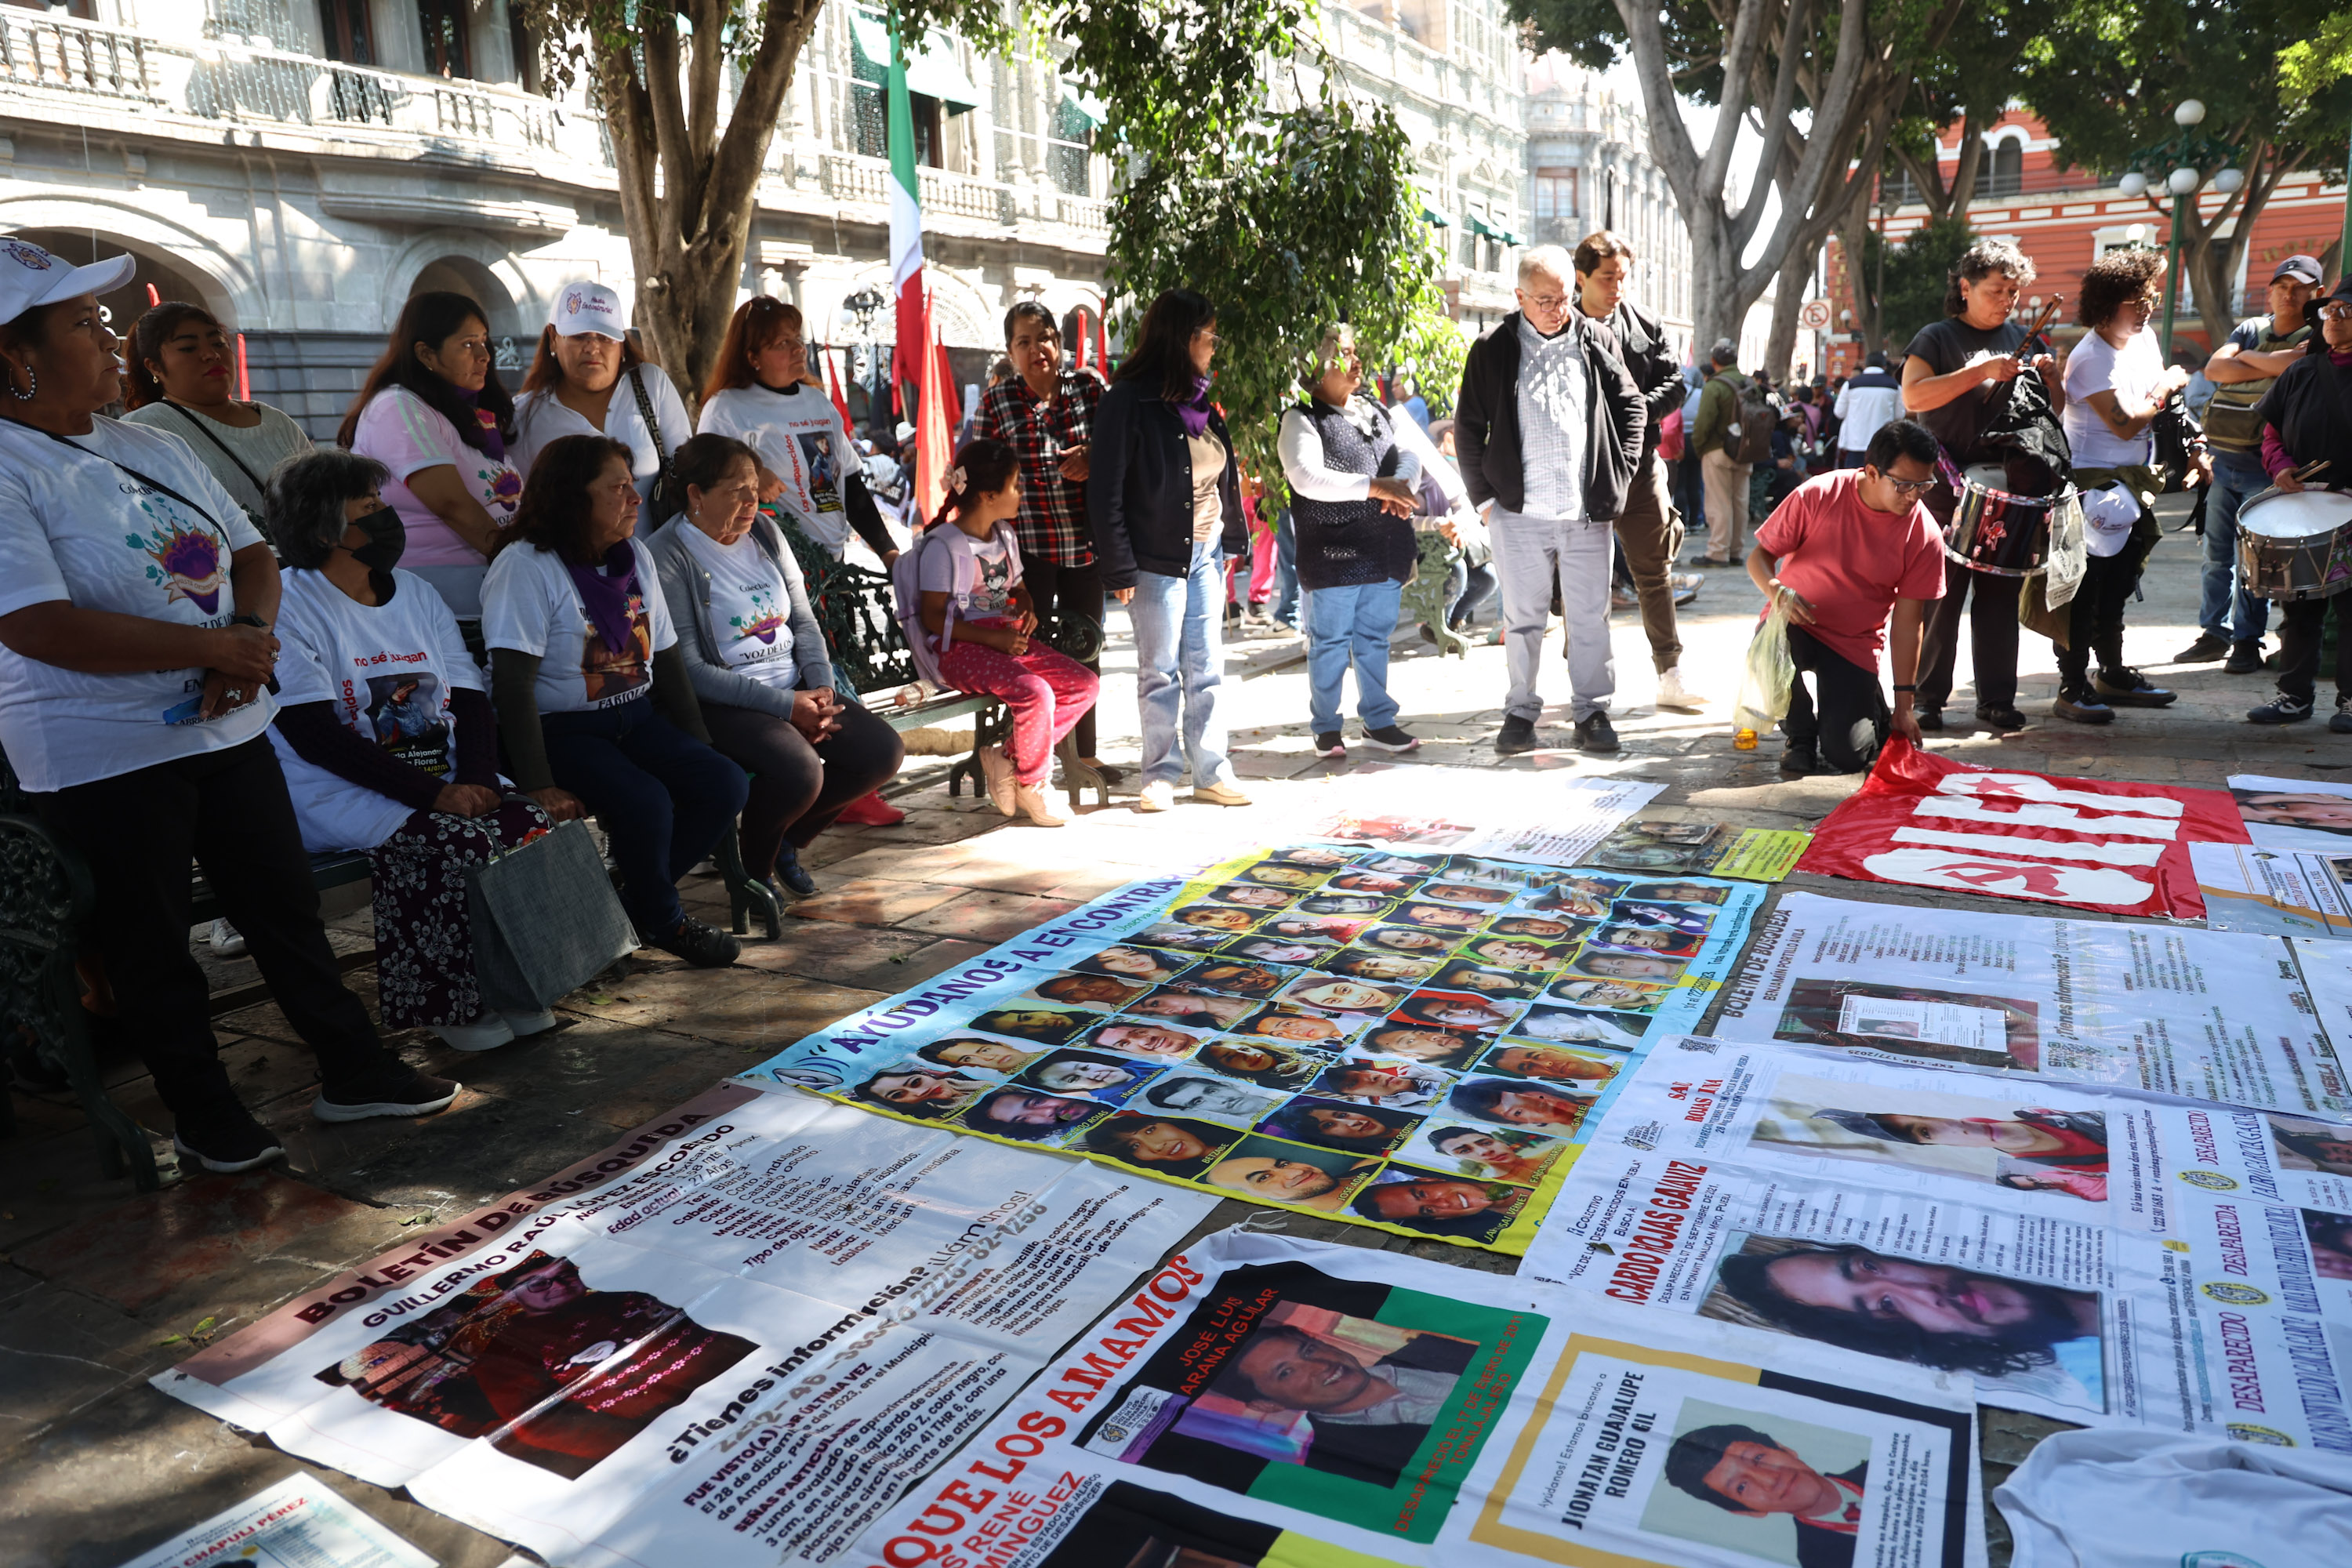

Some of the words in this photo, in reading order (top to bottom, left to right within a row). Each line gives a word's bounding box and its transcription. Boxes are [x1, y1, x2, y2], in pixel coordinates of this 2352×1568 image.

[354, 657, 368, 666] no
[371, 651, 387, 664] sé
[768, 644, 777, 655] DE
[779, 640, 791, 651] LOS
[414, 757, 437, 766] Flores
[829, 957, 1025, 1054] AYÚDANOS
[1010, 949, 1054, 963] A
[1087, 1109, 1109, 1125] ROJAS
[1684, 1098, 1713, 1123] ROJAS
[2187, 1110, 2220, 1166] DESAPARECIDO
[1201, 1142, 1230, 1164] BETZABE
[607, 1210, 644, 1235] Edad
[690, 1170, 710, 1187] 27
[705, 1157, 735, 1180] Años
[672, 1197, 724, 1226] Cabello:
[684, 1192, 712, 1207] Tez:
[699, 1203, 738, 1224] Color:
[783, 1149, 822, 1174] oscuro.
[714, 1207, 751, 1225] Cara:
[742, 1249, 773, 1268] Tipo
[771, 1236, 791, 1251] de
[789, 1223, 819, 1242] ojos:
[872, 1152, 921, 1183] rasgados.
[808, 1229, 845, 1251] Nariz:
[917, 1148, 964, 1177] mediana.
[1337, 1182, 1356, 1202] JOSÉ
[1352, 1171, 1370, 1190] ADAN
[1575, 1195, 1603, 1230] COLECTIVO
[1590, 1189, 1626, 1242] DESAPARECIDOS
[361, 1254, 506, 1329] GUILLERMO
[505, 1210, 569, 1256] RAÚL
[566, 1184, 637, 1212] LÓPEZ
[638, 1124, 735, 1184] ESCOBEDO
[711, 1209, 765, 1238] Mentón:
[732, 1212, 777, 1238] Orejas:
[746, 1217, 791, 1240] Frente:
[764, 1219, 804, 1242] Cejas:
[822, 1234, 860, 1257] Boca:
[829, 1239, 876, 1267] Labios:
[1004, 1267, 1029, 1291] color
[1071, 1196, 1108, 1229] navideño
[1613, 1216, 1634, 1237] BUSCA
[1628, 1210, 1685, 1256] ROJAS
[1658, 1259, 1683, 1304] DESAPARECIÓ
[1689, 1205, 1710, 1241] SEPTIEMBRE
[2214, 1205, 2248, 1276] DESAPARECIDA
[294, 1229, 480, 1327] BOLETÍN
[473, 1201, 534, 1232] DE
[971, 1300, 1011, 1325] imagen
[1017, 1267, 1047, 1290] Santa
[1072, 1228, 1095, 1247] reno.
[1000, 1305, 1034, 1333] -Botas
[1127, 1206, 1150, 1225] negro
[1002, 1240, 1041, 1276] mezclilla
[1605, 1252, 1665, 1305] ICARDO
[927, 1267, 996, 1317] VESTIMENTA
[986, 1289, 1039, 1328] -Chamarra
[1047, 1262, 1067, 1283] piel
[1011, 1312, 1044, 1337] líneas
[1041, 1298, 1068, 1318] rojas.
[667, 1377, 775, 1465] ¿Tienes
[925, 1189, 1030, 1269] ¡Llámanos!
[1179, 1329, 1221, 1369] JOSÉ
[1214, 1294, 1243, 1332] LUIS
[1179, 1341, 1233, 1396] ARANA
[1227, 1286, 1279, 1345] AGUILAR
[968, 1409, 1067, 1495] LOS
[1045, 1254, 1206, 1414] AMAMOS
[2219, 1311, 2266, 1414] DESAPARECIDO
[682, 1479, 717, 1508] FUE
[710, 1427, 779, 1483] VISTO(A)
[799, 1381, 850, 1423] ÚLTIMA
[846, 1361, 874, 1385] VEZ
[795, 1445, 847, 1500] ovalado
[858, 1359, 960, 1438] aproximadamente
[827, 1388, 864, 1420] 2023,
[829, 1451, 861, 1487] lado
[922, 1359, 978, 1399] abdomen.
[1394, 1441, 1454, 1533] DESAPARECIÓ
[1446, 1425, 1464, 1441] EL
[1464, 1392, 1483, 1410] DE
[1504, 1314, 1524, 1338] 2011
[1595, 1371, 1645, 1452] GUADALUPE
[735, 1460, 793, 1508] Amozoc,
[782, 1475, 864, 1553] -Motocicleta
[927, 1386, 959, 1416] color
[953, 1363, 990, 1397] negro,
[814, 1534, 849, 1565] caja
[844, 1500, 884, 1541] negra
[908, 1446, 943, 1478] parte
[953, 1406, 987, 1439] atrás.
[1537, 1461, 1568, 1508] Ayúdanos!
[1560, 1421, 1585, 1460] Estamos
[1604, 1437, 1646, 1498] ROMERO
[1631, 1412, 1657, 1433] GIL
[256, 1497, 310, 1530] PÉREZ
[733, 1490, 786, 1534] SEÑAS
[797, 1519, 846, 1561] placas
[858, 1443, 924, 1506] circulación
[961, 1490, 1037, 1555] RENÉ
[1030, 1513, 1062, 1548] ESTADO
[1071, 1473, 1102, 1502] JALISCO
[1052, 1481, 1104, 1541] DESAPARECER
